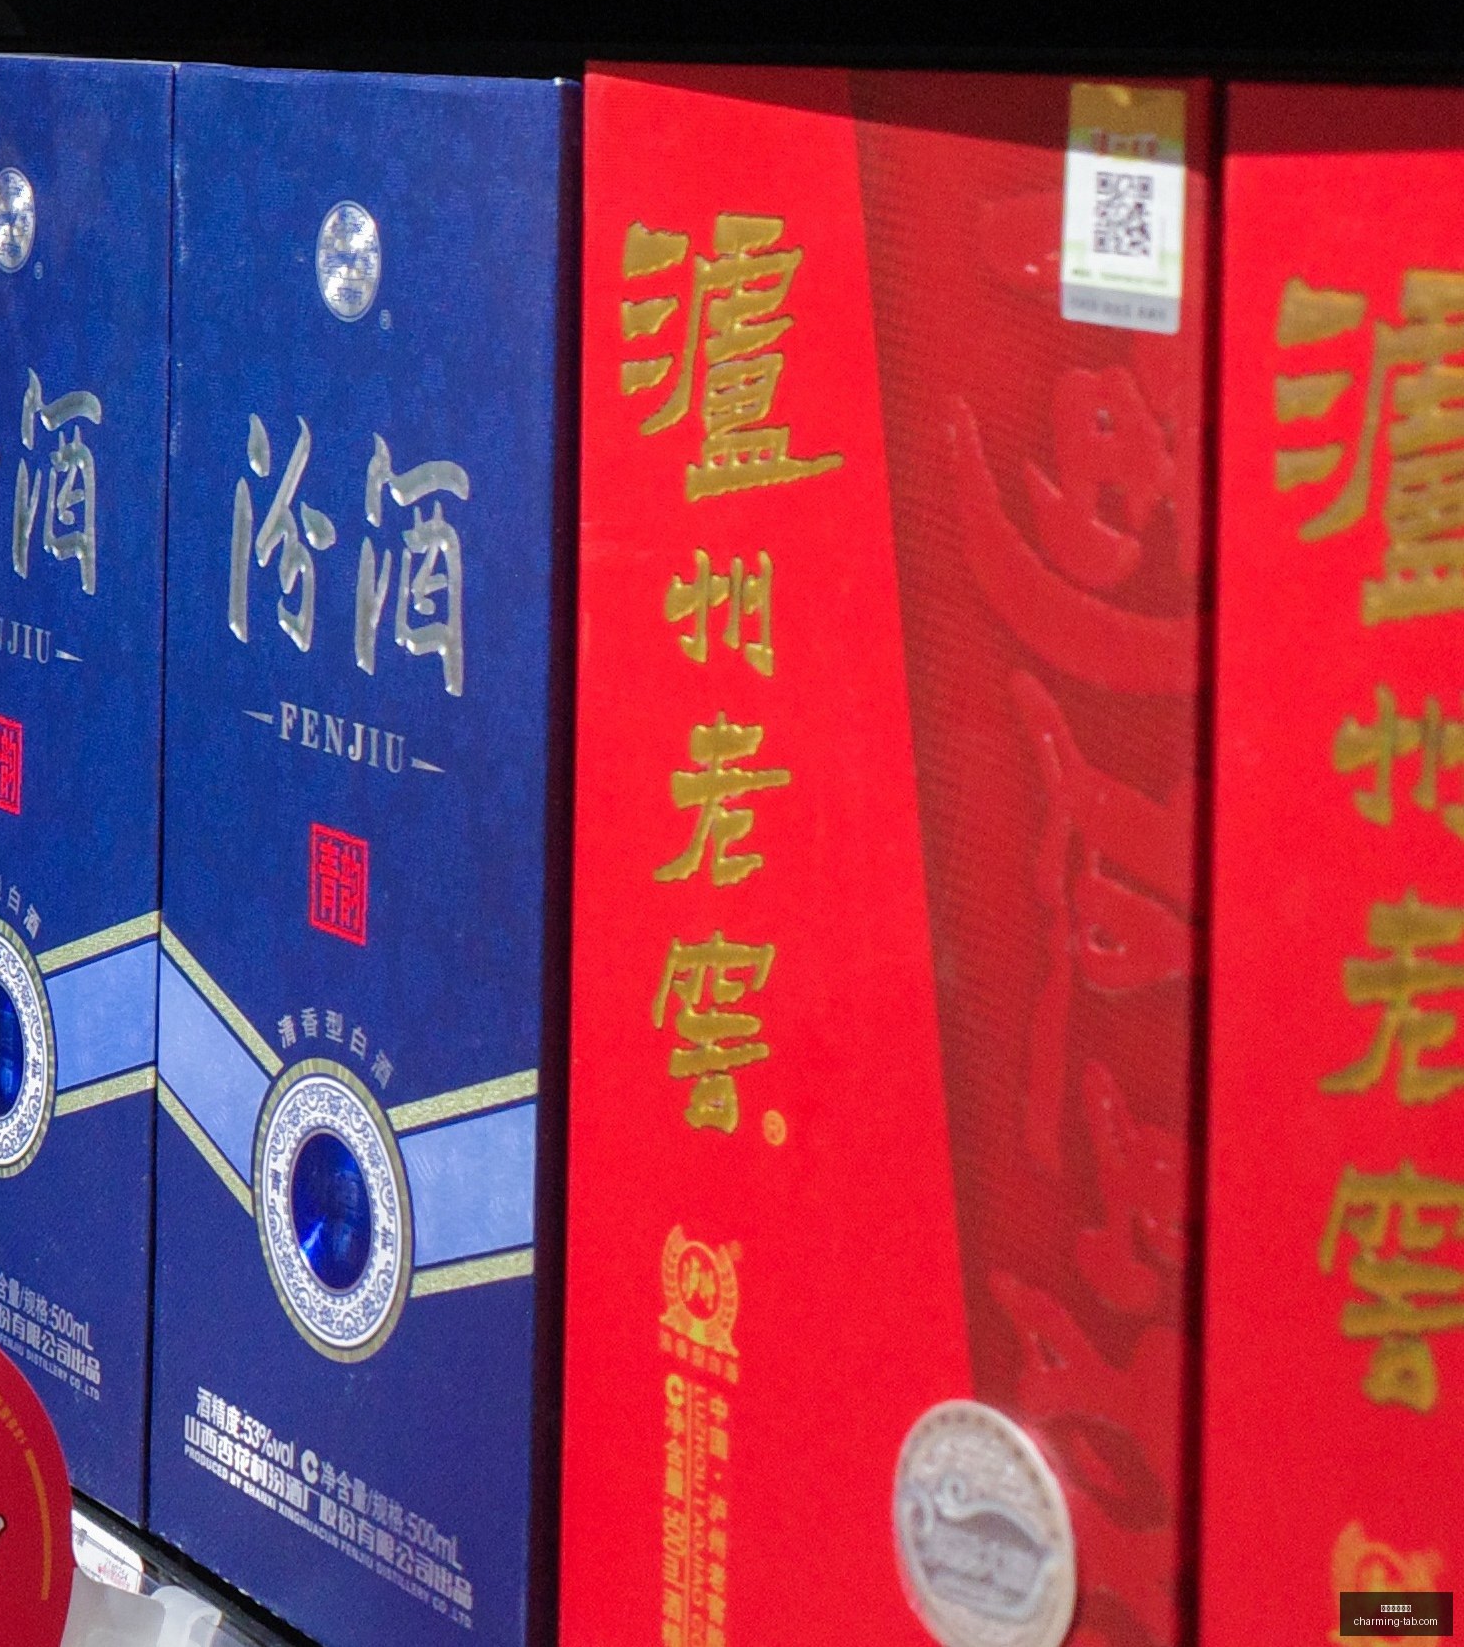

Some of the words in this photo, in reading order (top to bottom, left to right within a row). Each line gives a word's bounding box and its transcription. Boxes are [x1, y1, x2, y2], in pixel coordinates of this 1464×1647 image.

[228, 412, 470, 698] 汾酒
[278, 700, 407, 776] FENJIU
[277, 1006, 395, 1091] 清香型白酒
[183, 1443, 230, 1481] PRODUCED
[230, 1471, 242, 1489] BY
[243, 1478, 277, 1512] SHANXI
[184, 1413, 474, 1611] 山西杏花村汾酒厂股份有限公司出品
[196, 1385, 296, 1470] 酒精度:53%vol
[320, 1460, 463, 1571] 净含量/规格:500mL
